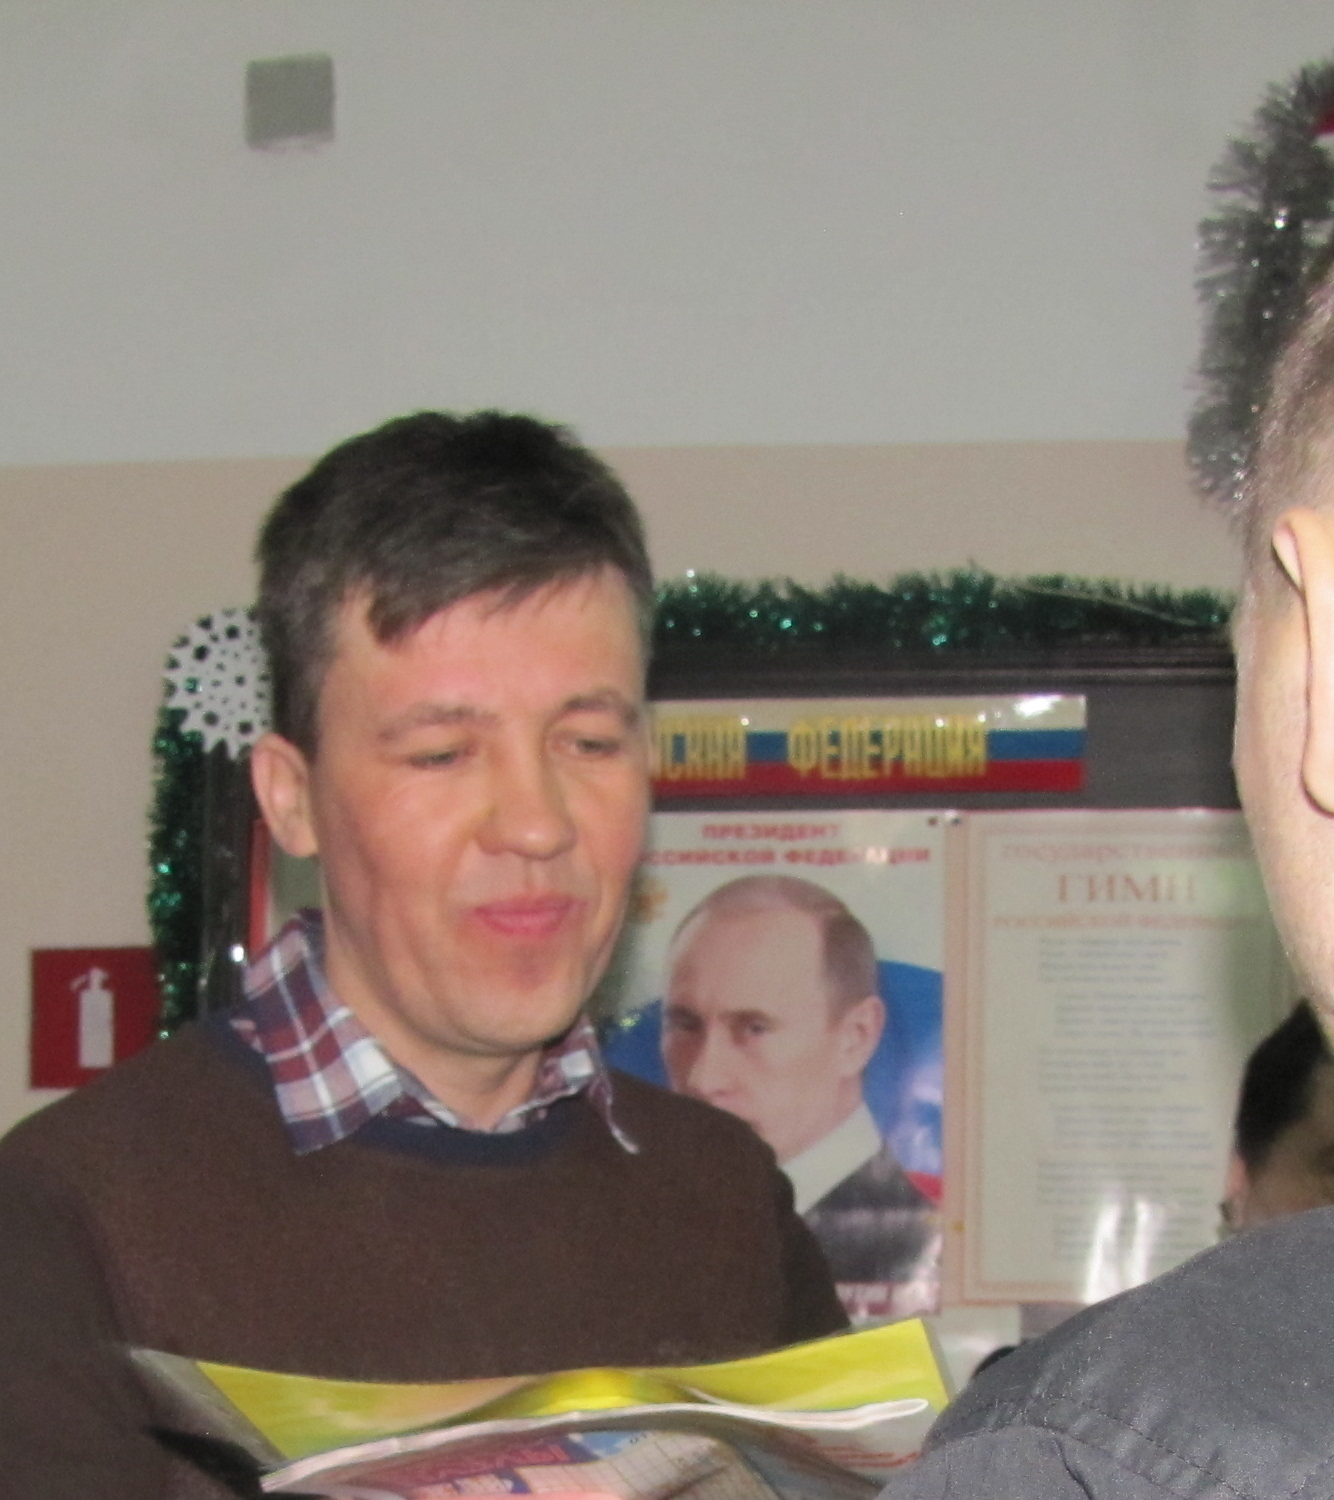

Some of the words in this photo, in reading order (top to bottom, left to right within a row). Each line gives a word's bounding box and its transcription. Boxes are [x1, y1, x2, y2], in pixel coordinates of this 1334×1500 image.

[786, 714, 986, 780] ФЕДЕРАЦИЯ
[784, 847, 931, 866] ФЕДЕЦИИ
[1057, 873, 1197, 903] ГИМН
